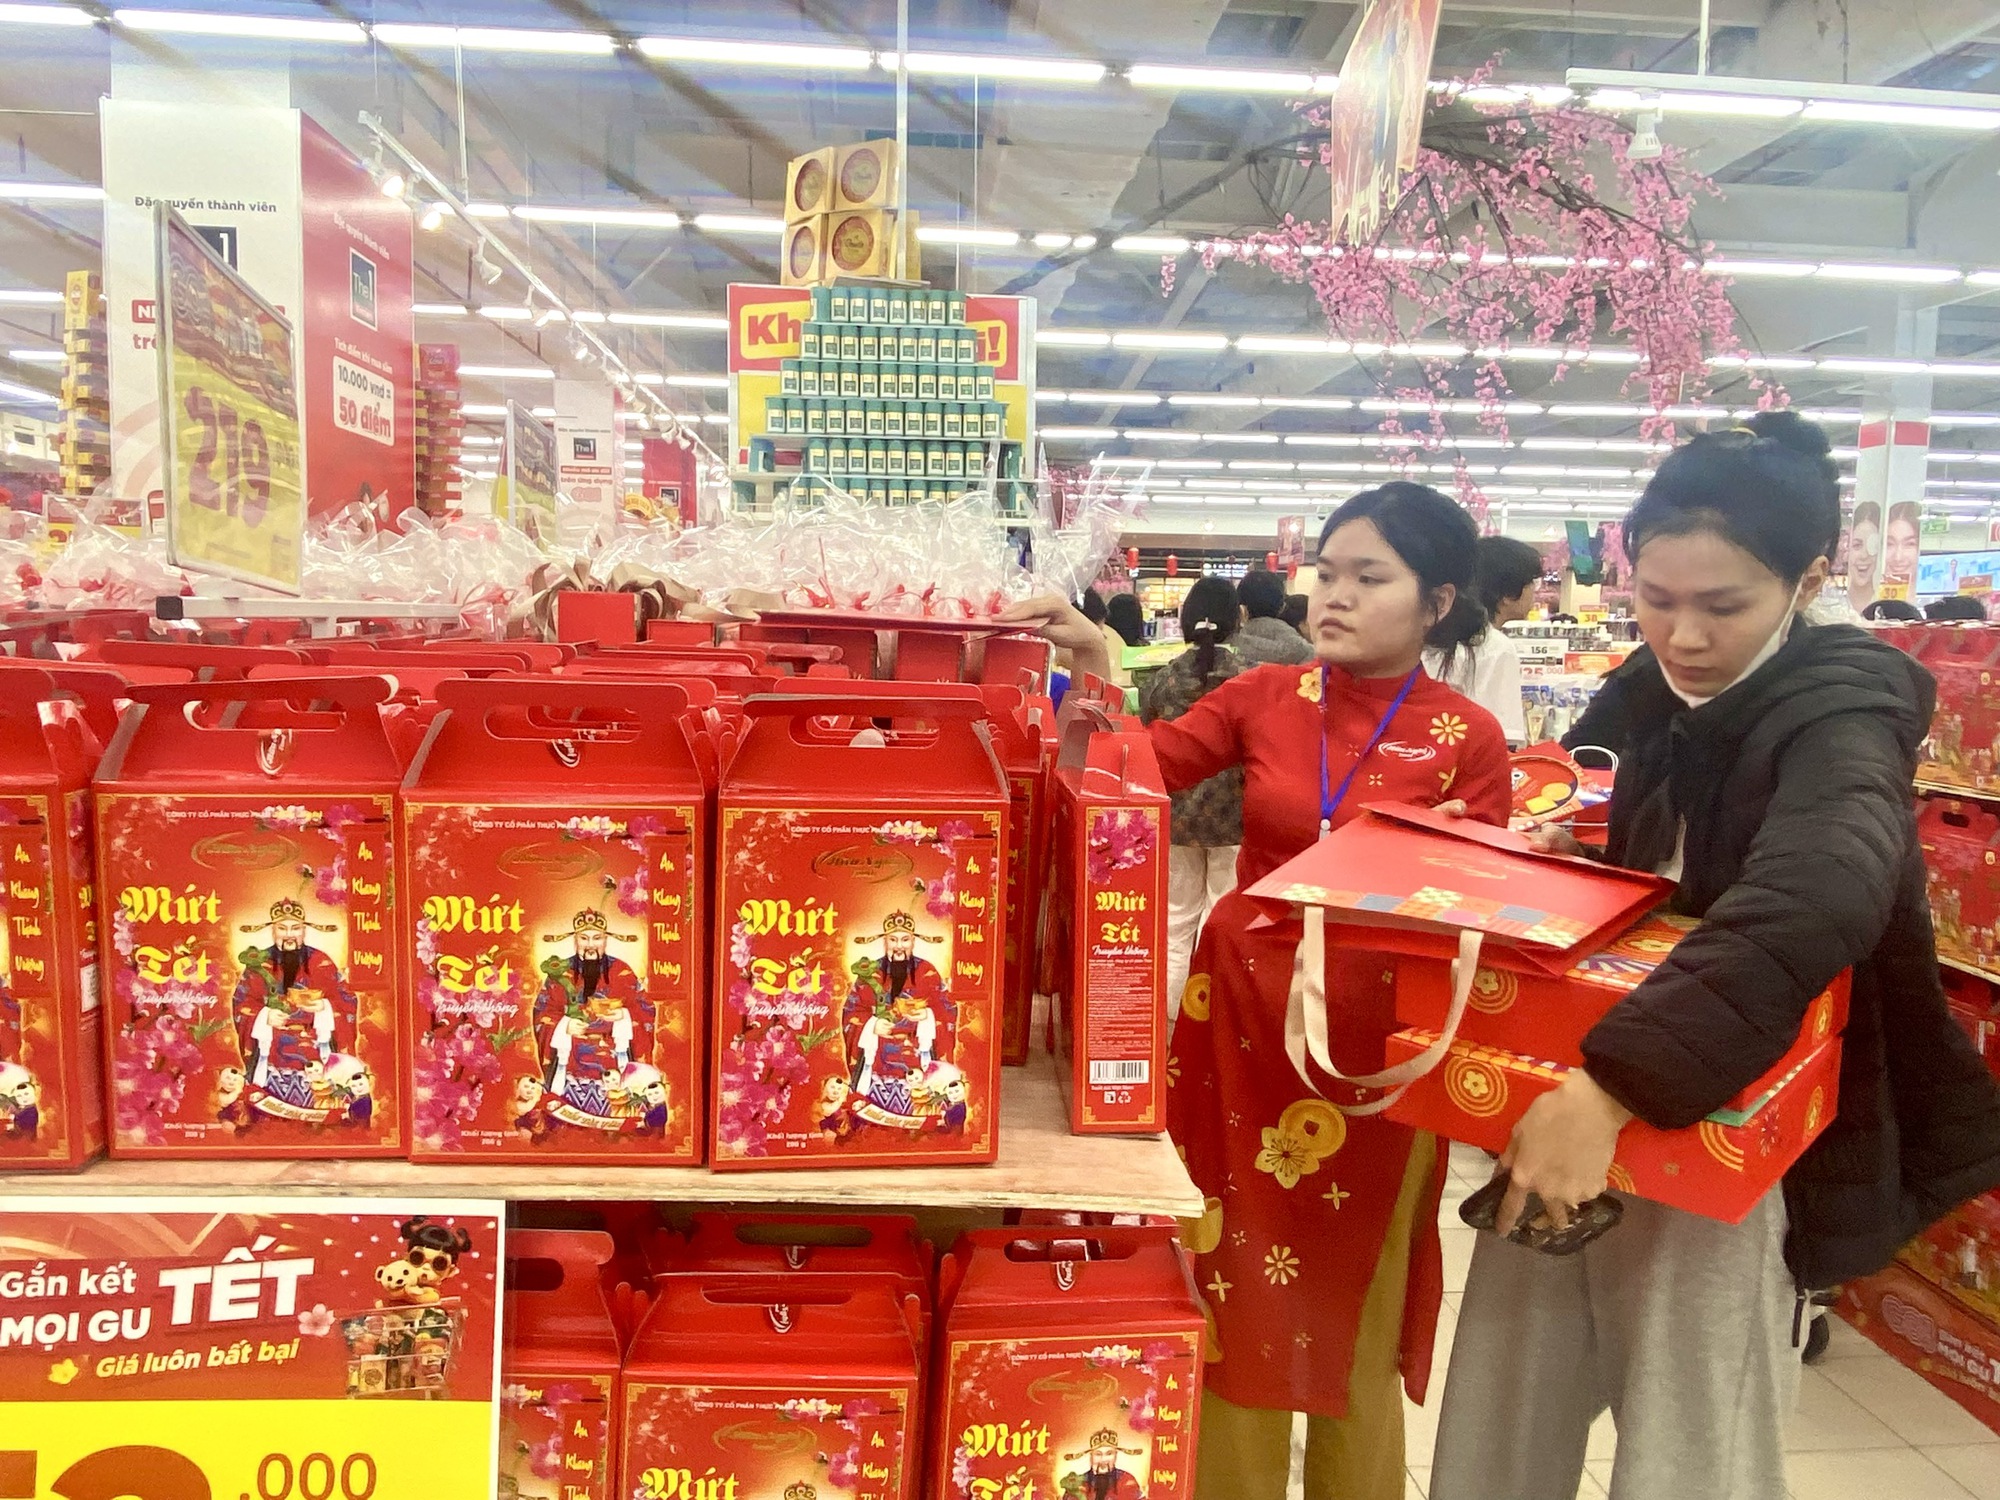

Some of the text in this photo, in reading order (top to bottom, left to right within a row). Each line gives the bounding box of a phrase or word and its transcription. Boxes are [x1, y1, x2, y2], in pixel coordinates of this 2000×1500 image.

[208, 200, 245, 211] thành
[249, 201, 277, 213] viên
[338, 364, 368, 392] 10.000
[339, 396, 391, 438] 50 điểm
[1530, 646, 1548, 654] 156
[358, 841, 374, 861] An
[660, 852, 675, 873] An
[966, 856, 981, 875] An
[121, 883, 222, 924] Mứt
[352, 876, 381, 904] Khang
[653, 887, 681, 916] Khang
[959, 889, 985, 917] Khang
[1095, 890, 1147, 911] Mứt
[423, 893, 525, 934] Mứt
[740, 896, 839, 937] Mứt
[1101, 916, 1141, 943] Tết
[135, 935, 213, 984] Tết
[354, 950, 383, 975] Vượng
[437, 944, 514, 993] Tết
[653, 960, 682, 985] Vượng
[751, 947, 826, 995] Tết
[957, 960, 984, 986] Vượng
[0, 1261, 138, 1299] Gắn kết
[158, 1234, 315, 1326] TẾT
[0, 1306, 152, 1352] MỌI GU
[95, 1338, 301, 1378] Giá luôn bất bại
[1165, 1374, 1179, 1391] An
[573, 1419, 589, 1439] An
[870, 1430, 885, 1448] An
[962, 1419, 1051, 1458] Mứt
[641, 1466, 740, 1500] Mứt
